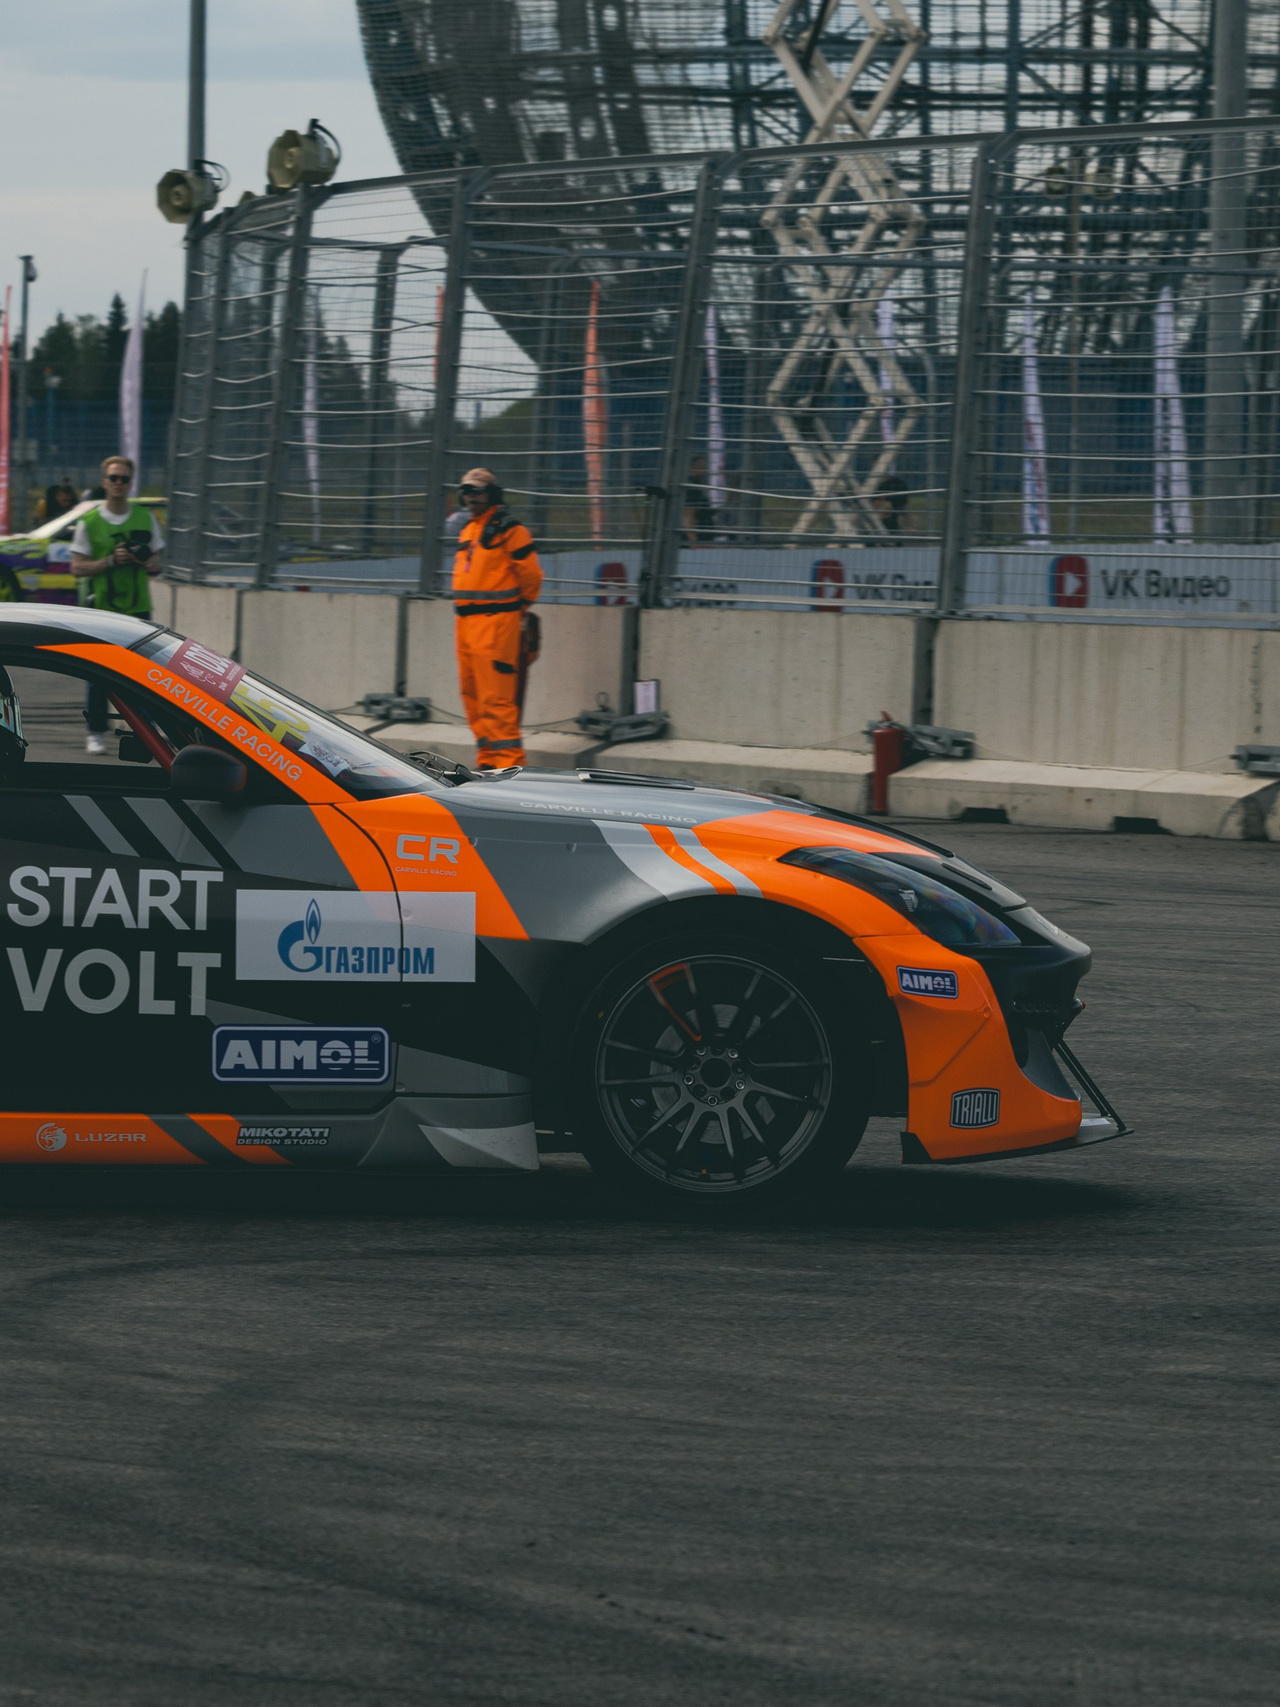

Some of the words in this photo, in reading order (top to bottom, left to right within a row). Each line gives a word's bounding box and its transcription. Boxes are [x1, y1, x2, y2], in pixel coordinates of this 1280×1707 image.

[853, 573, 887, 601] VK
[1101, 569, 1139, 598] VK
[1145, 569, 1231, 604] Видео
[146, 668, 233, 731] CARVILLE
[231, 725, 303, 781] RACING
[519, 802, 615, 816] CARVILLE
[620, 810, 698, 824] RACING
[396, 834, 460, 864] CR
[395, 866, 428, 874] CARVILLE
[430, 868, 457, 877] RACING
[6, 866, 224, 931] START
[324, 945, 435, 975] ГАЗПРОМ
[6, 946, 222, 1017] VOLT
[902, 972, 956, 992] AIMOL
[220, 1039, 380, 1071] AIMOL
[954, 1092, 998, 1125] TRIALLI
[75, 1132, 147, 1143] LUZAR
[237, 1138, 279, 1146] DESIGN
[283, 1138, 328, 1146] STUDIO
[239, 1127, 330, 1138] MIKOTATI
